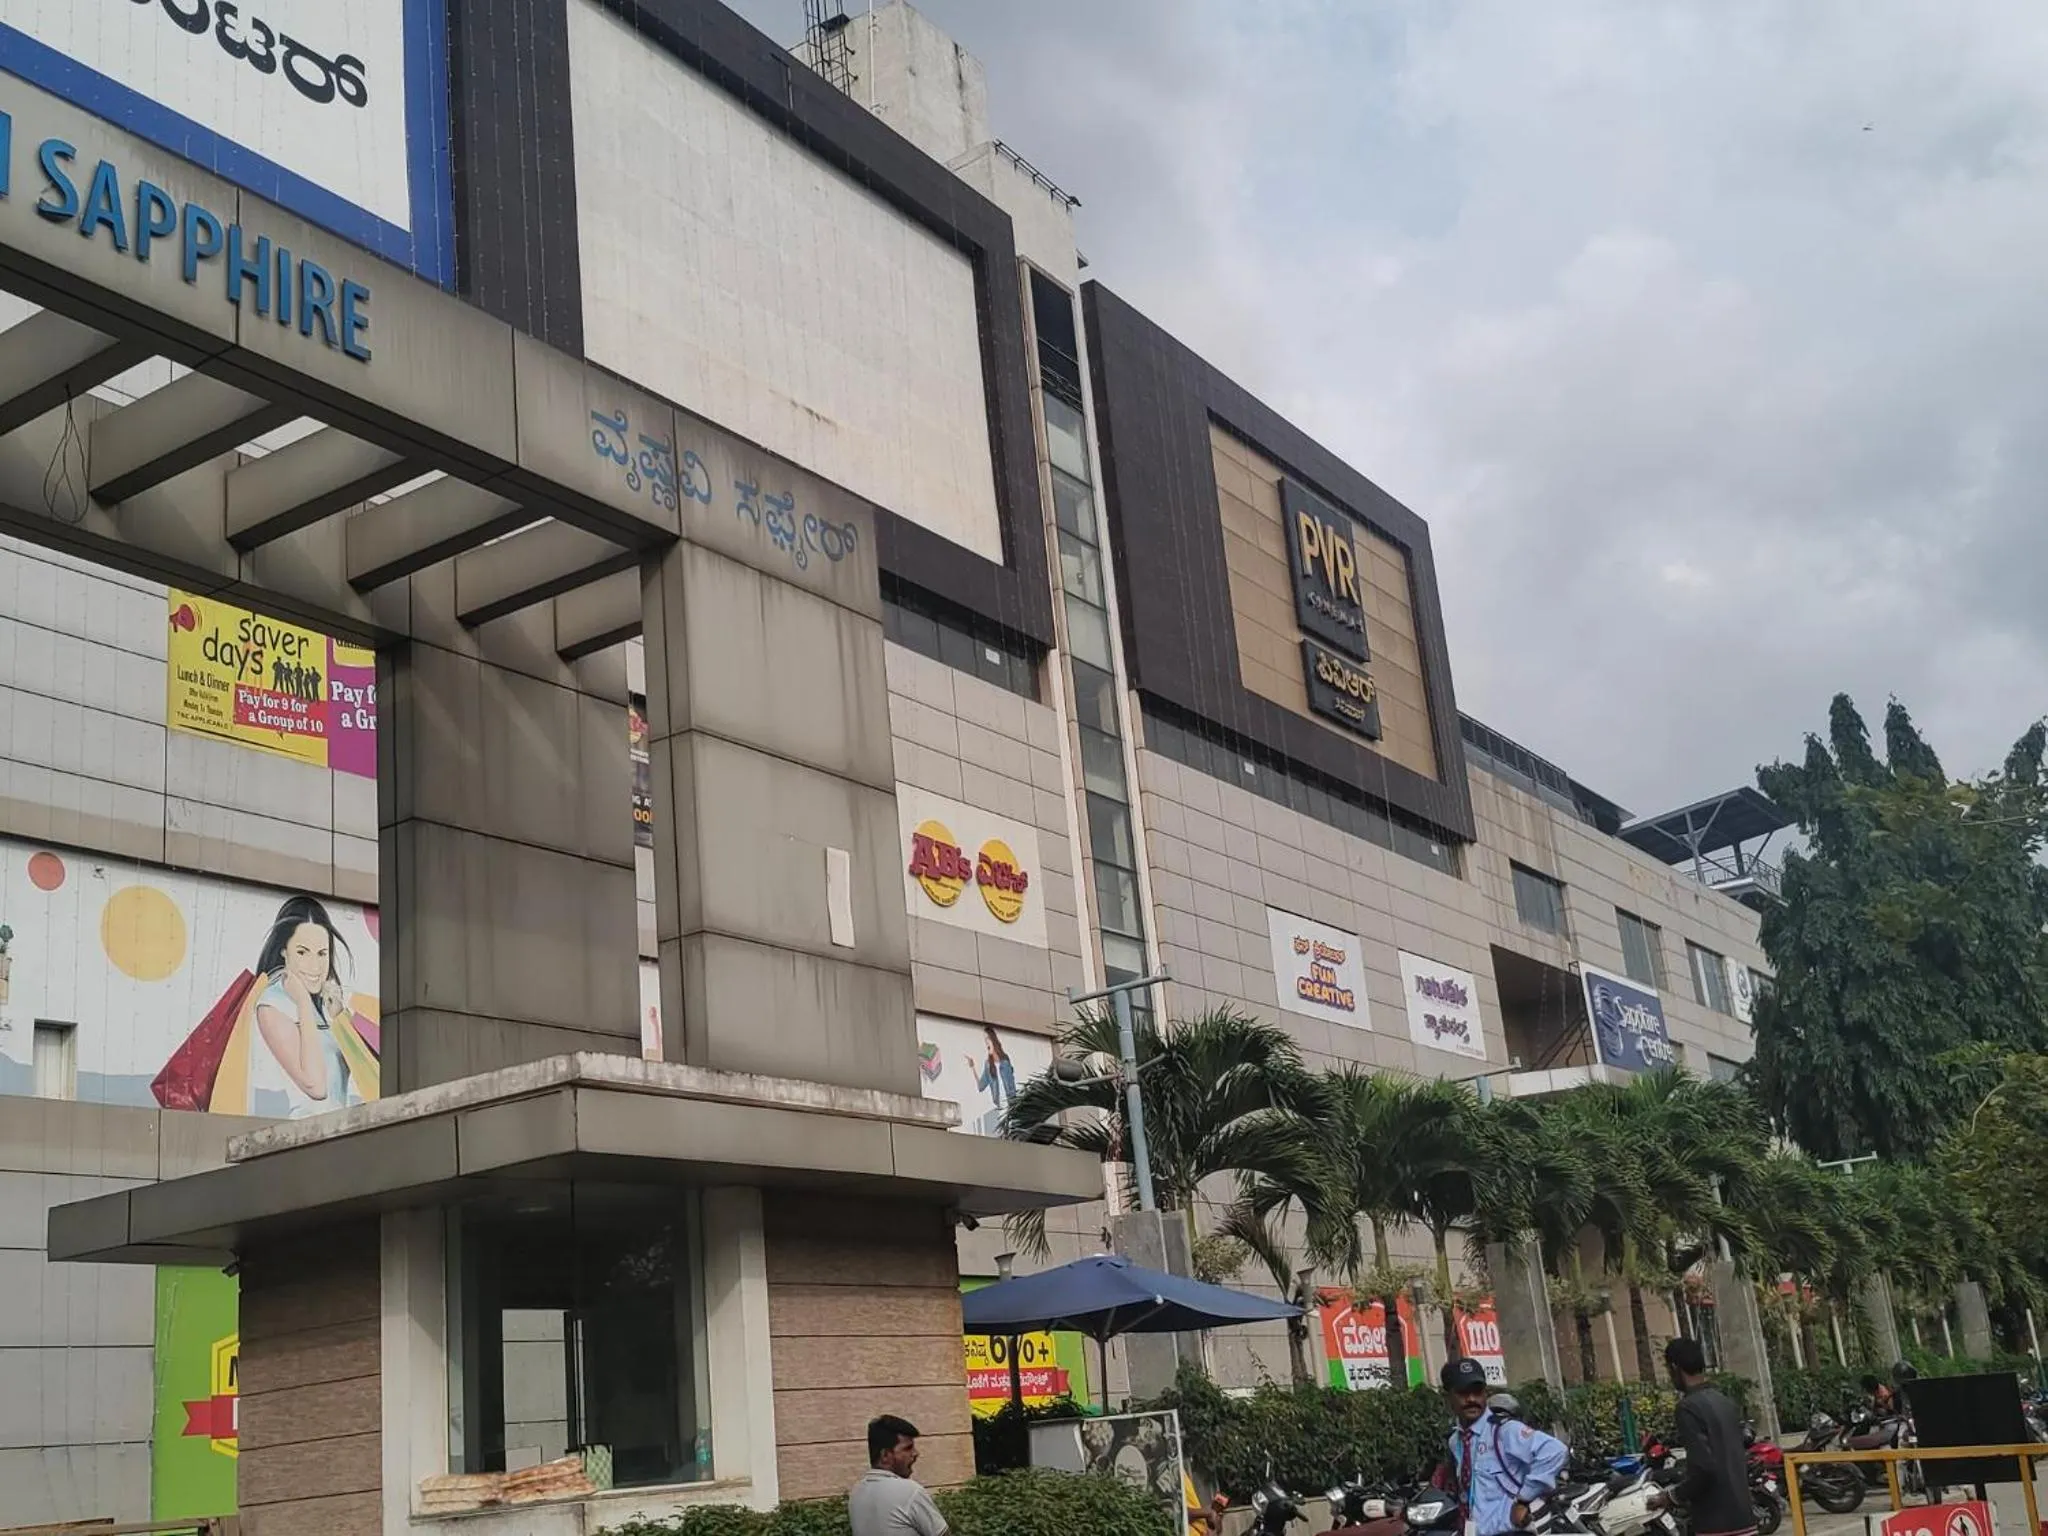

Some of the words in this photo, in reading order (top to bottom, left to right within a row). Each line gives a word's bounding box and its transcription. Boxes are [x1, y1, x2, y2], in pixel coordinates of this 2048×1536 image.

[36, 138, 372, 362] SAPPHIRE
[1297, 511, 1360, 606] PVR
[238, 617, 309, 658] saver
[202, 627, 264, 680] days
[177, 665, 198, 684] Lunch
[199, 671, 206, 686] &
[207, 672, 230, 692] Dinner
[238, 689, 260, 709] Pay
[263, 693, 280, 709] for
[281, 697, 289, 710] 9
[290, 698, 308, 714] for
[331, 680, 364, 708] Pay
[248, 711, 257, 723] a
[258, 709, 295, 732] Group
[296, 716, 308, 731] of
[310, 719, 323, 733] 10
[340, 711, 353, 729] a
[1311, 962, 1336, 987] FUN
[1297, 977, 1355, 1012] CREATIVE
[1467, 1321, 1500, 1351] mo
